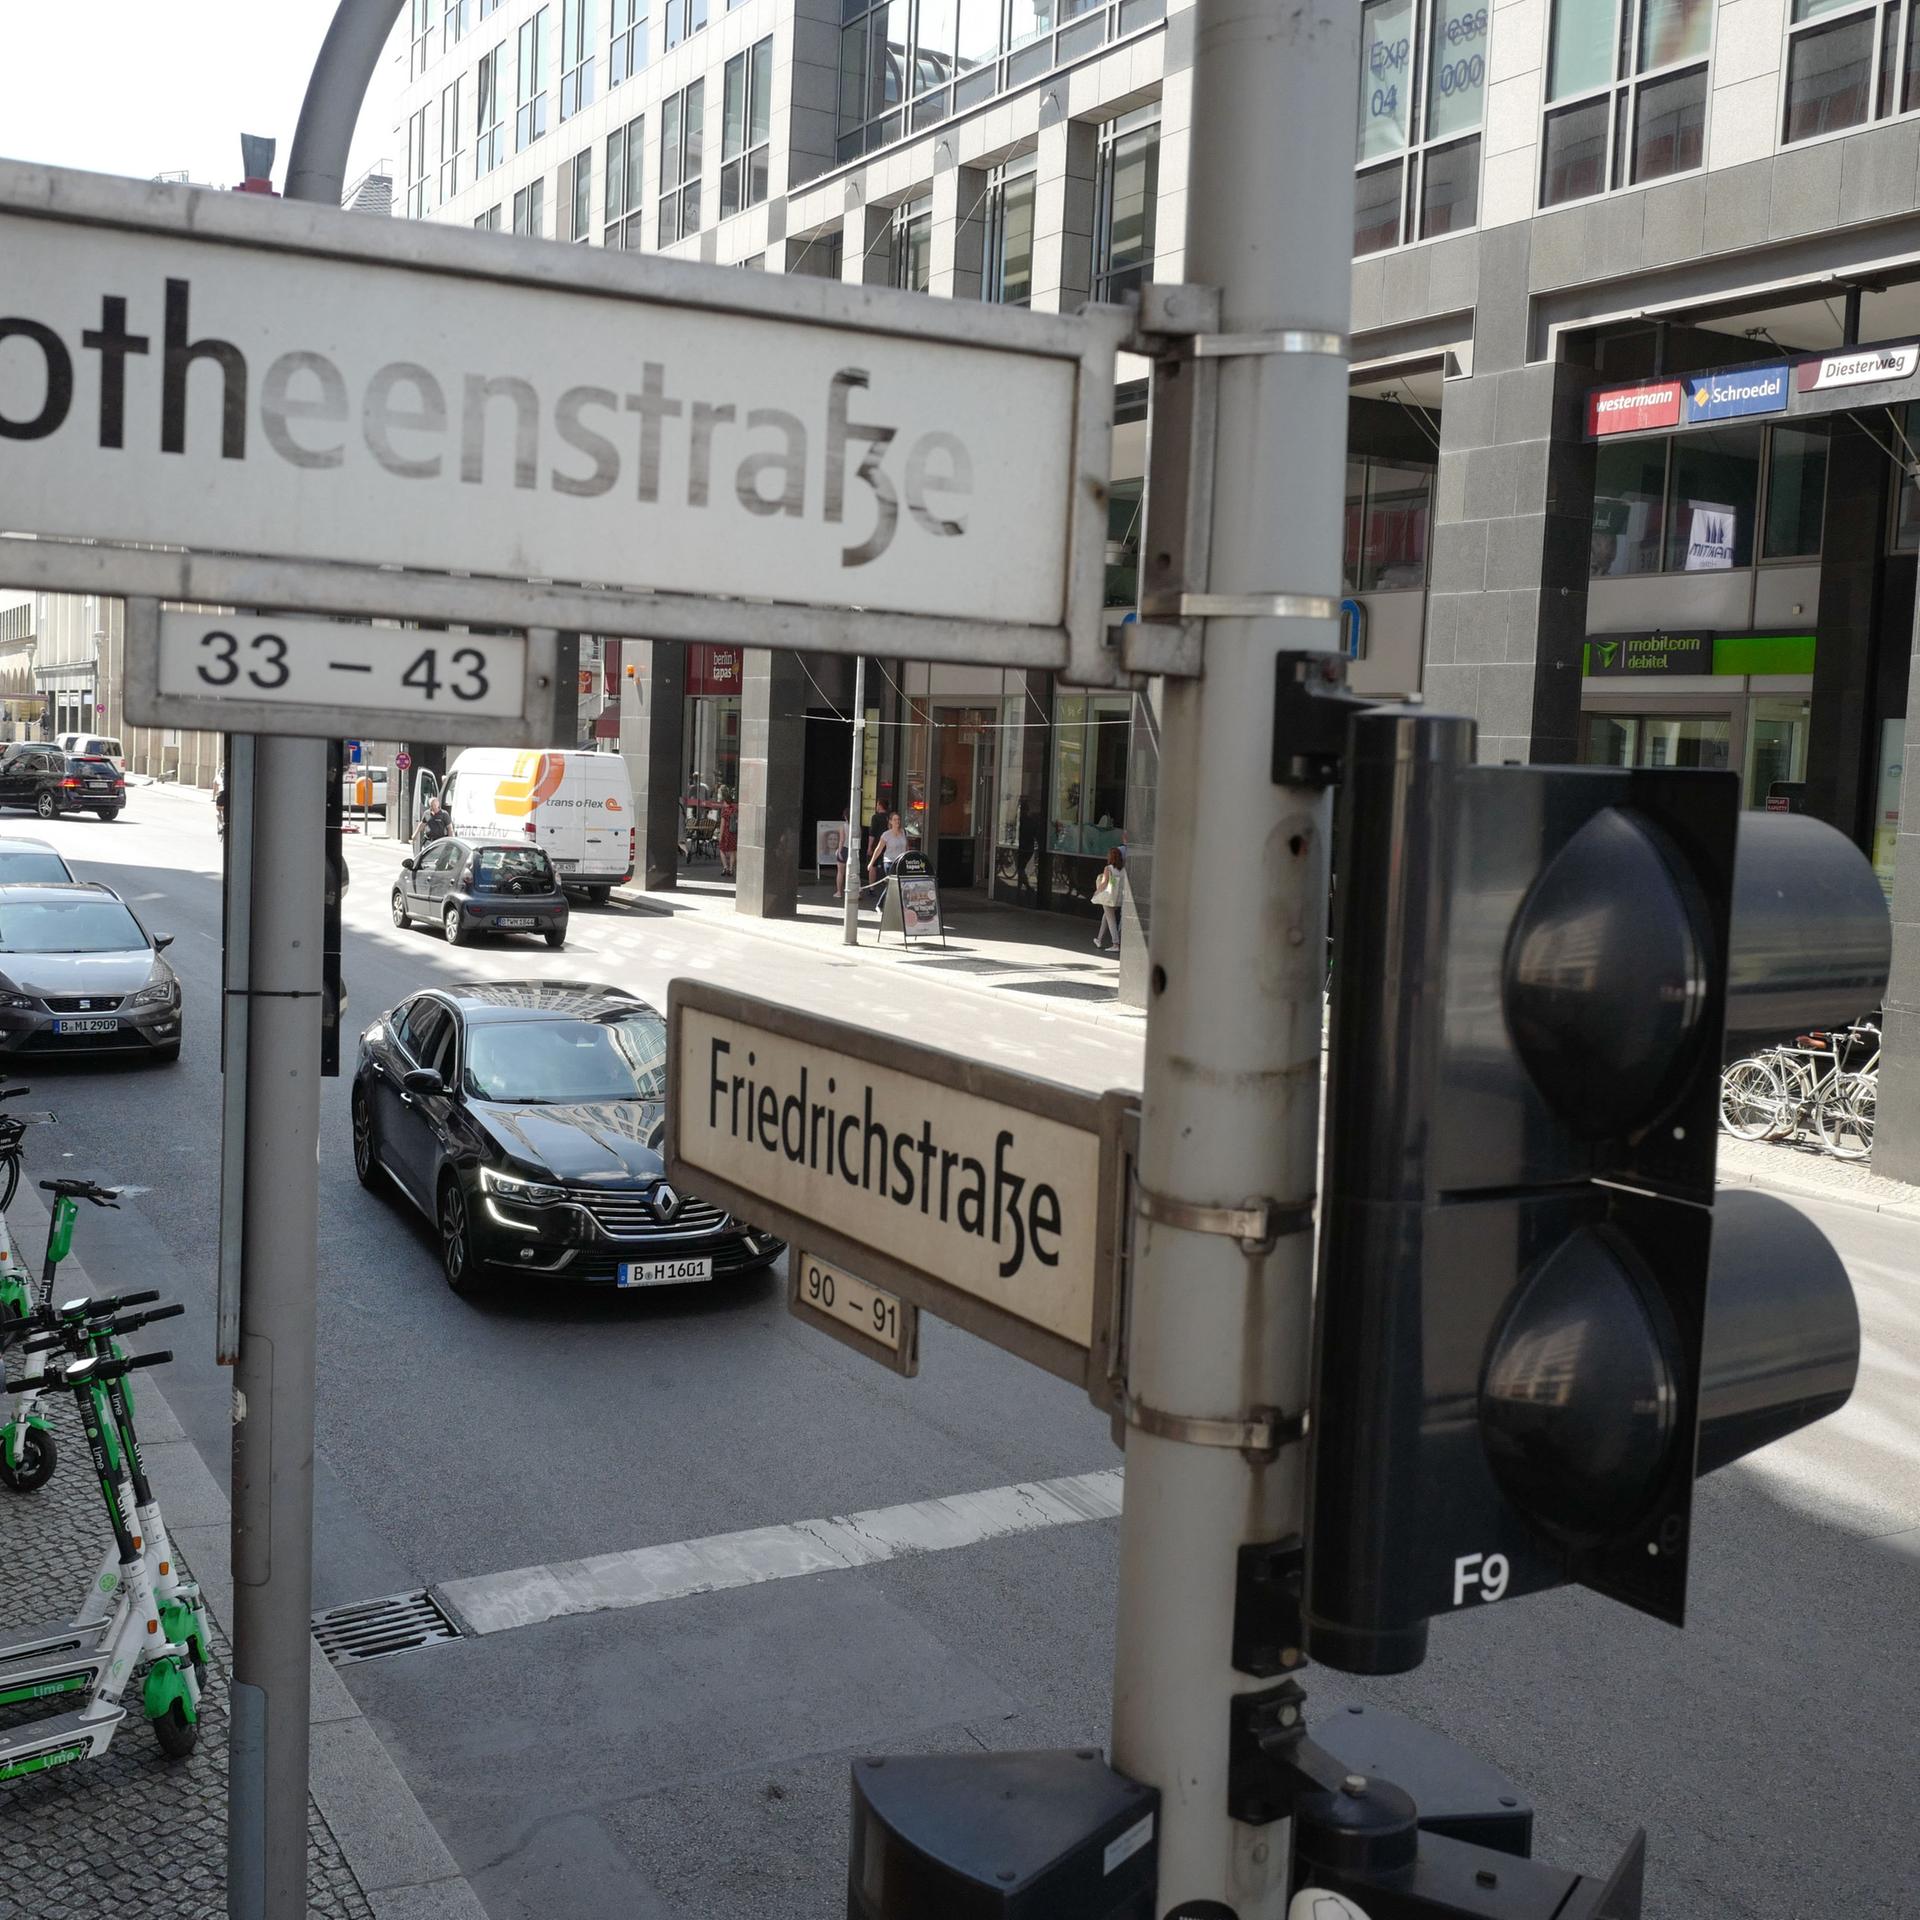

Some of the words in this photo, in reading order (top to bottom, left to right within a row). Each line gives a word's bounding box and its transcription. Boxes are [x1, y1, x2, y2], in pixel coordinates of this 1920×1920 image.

[1825, 354, 1906, 380] Diesterweg
[1596, 388, 1673, 413] westermann
[1712, 378, 1780, 404] Schroedel
[0, 277, 973, 568] otheenstraße
[1628, 636, 1700, 651] mobilcom
[197, 630, 290, 689] 33
[402, 648, 490, 701] 43
[713, 651, 733, 665] berlin
[1628, 654, 1668, 668] debitel
[713, 666, 732, 681] tapas
[61, 1021, 68, 1032] B
[709, 1036, 1063, 1279] Friedrichstraße
[633, 1266, 644, 1281] B
[808, 1266, 836, 1308] 90
[872, 1297, 896, 1339] 91
[111, 1393, 123, 1416] Lime
[92, 1446, 104, 1470] Lime
[1453, 1552, 1510, 1606] F9
[33, 1683, 65, 1697] Lime
[43, 1751, 75, 1768] Lime
